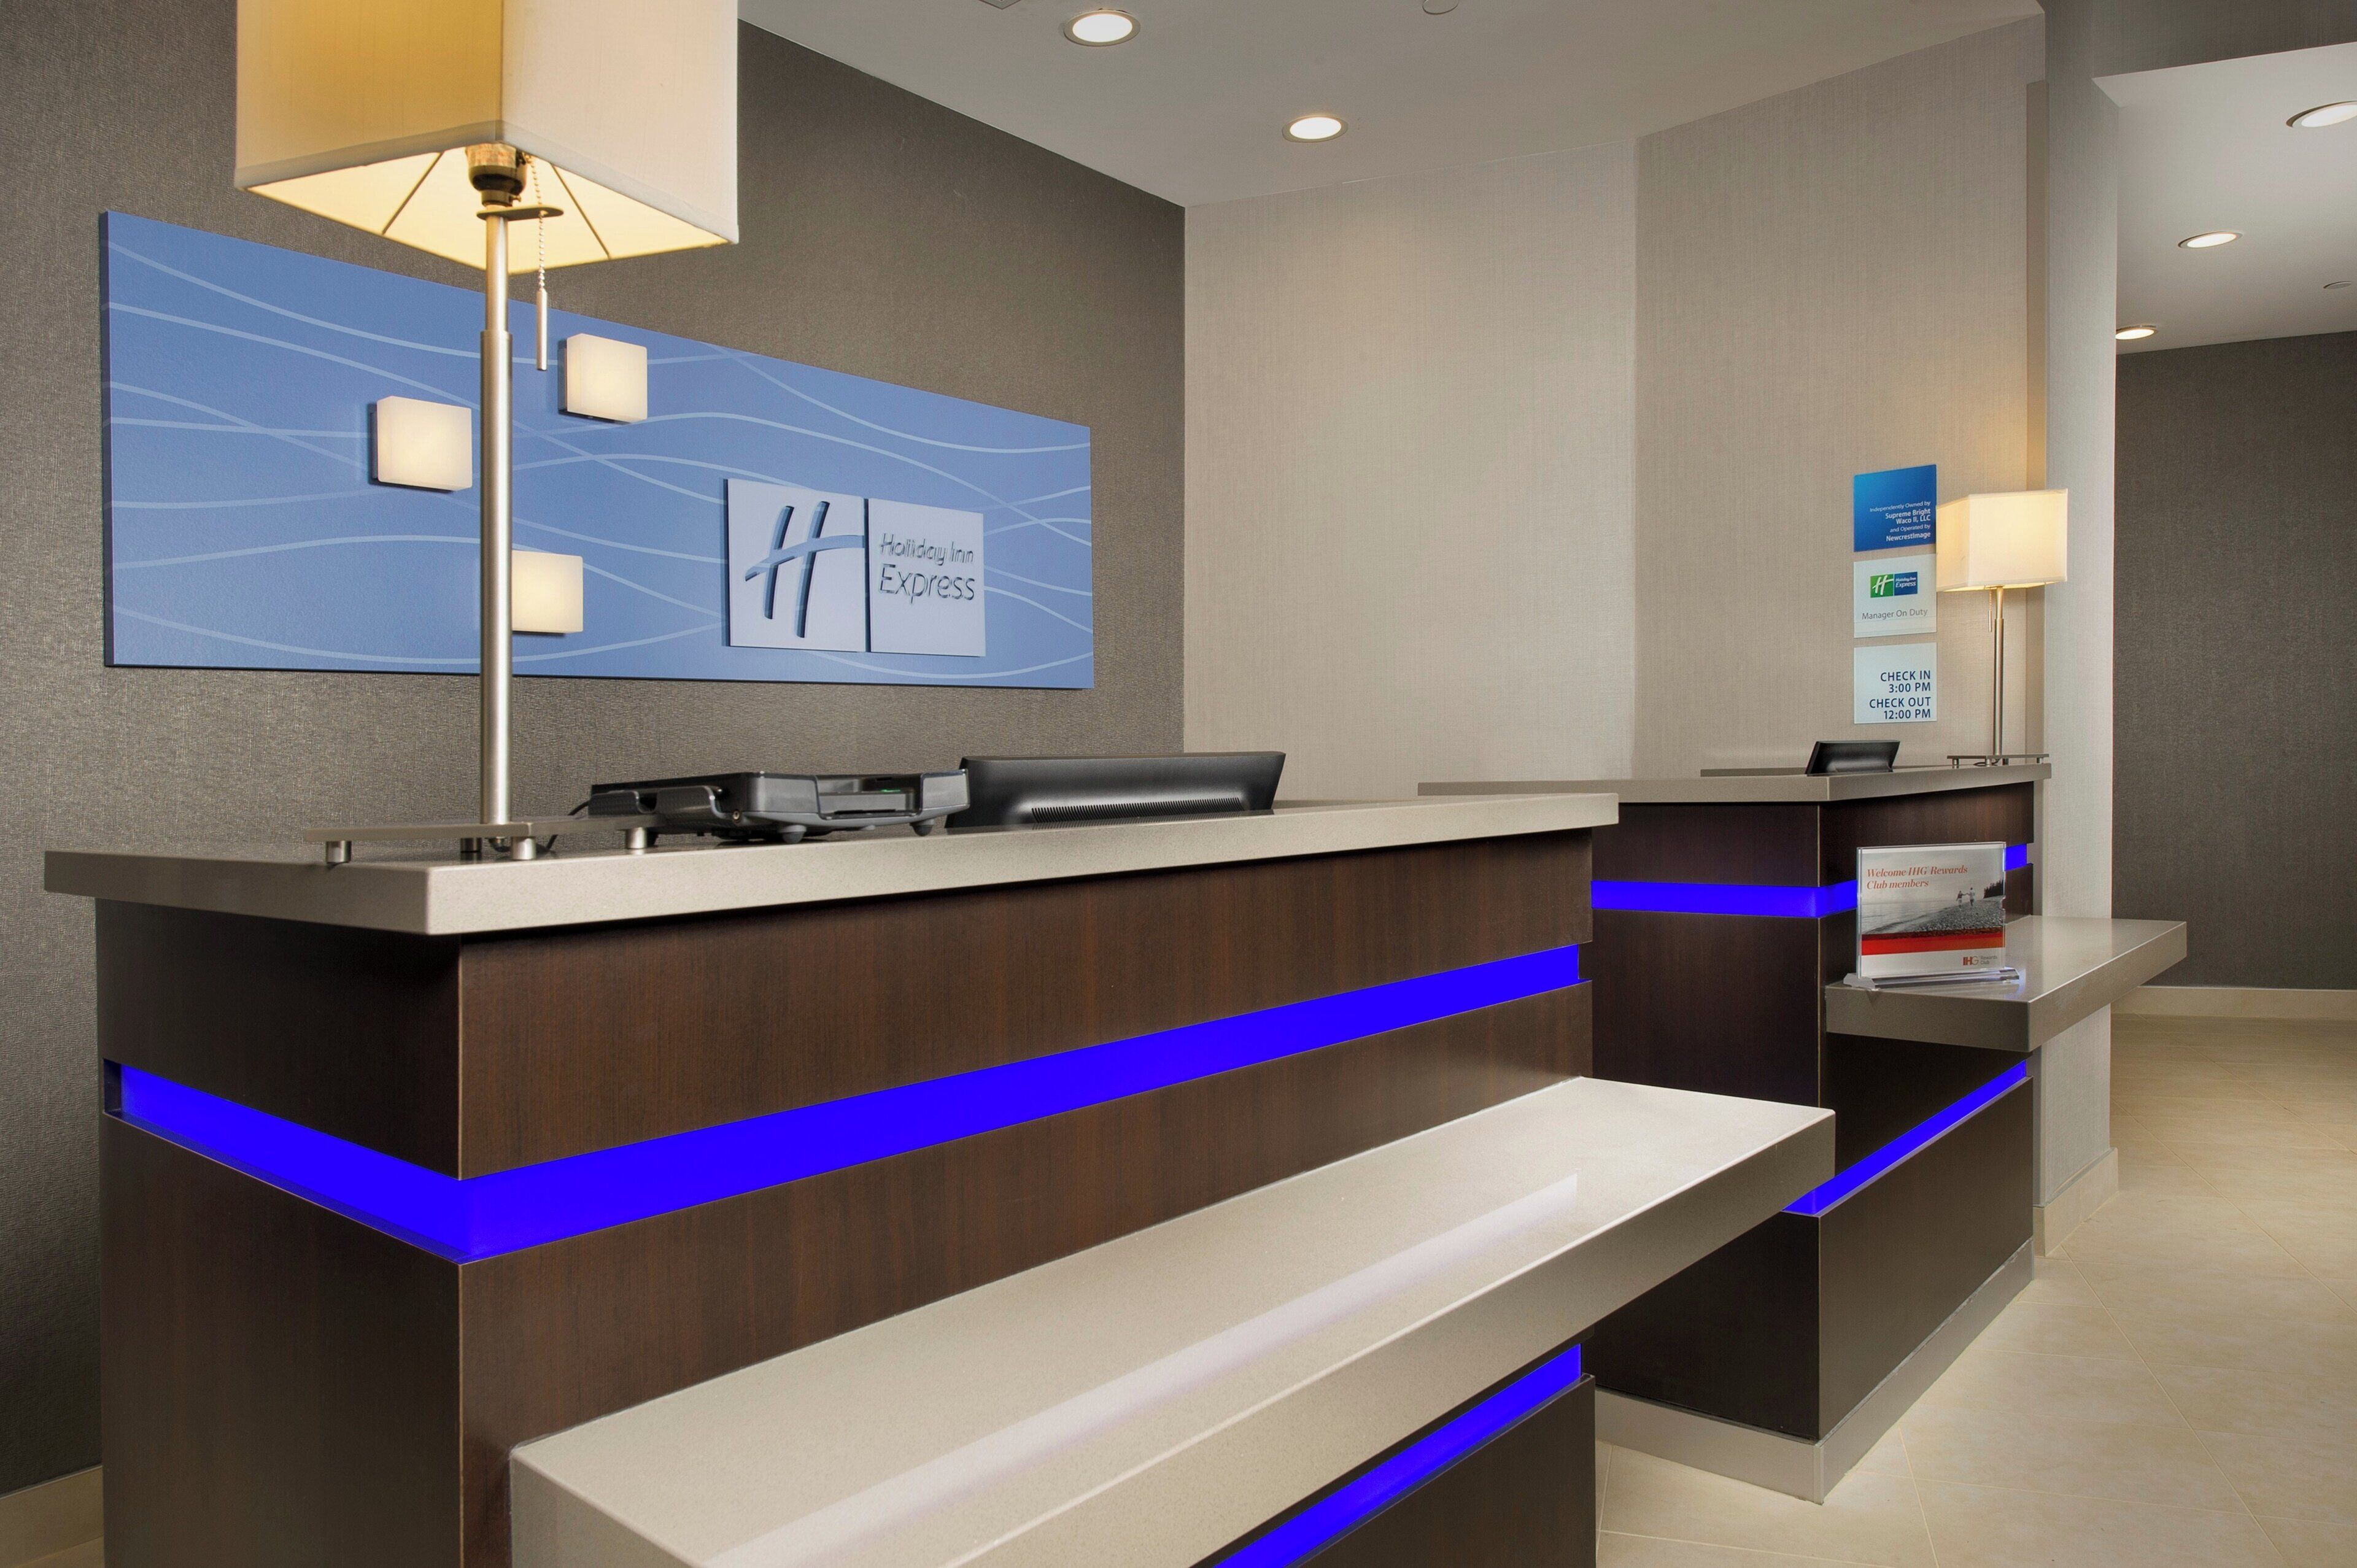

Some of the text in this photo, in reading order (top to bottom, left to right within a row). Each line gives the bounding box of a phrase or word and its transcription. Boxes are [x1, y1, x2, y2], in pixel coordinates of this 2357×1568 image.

[1886, 511, 1911, 519] Supreme
[1886, 532, 1930, 541] NewcrestImage
[880, 533, 973, 566] Holiday Inn
[880, 563, 975, 604] Express
[1881, 670, 1930, 681] CHECK IN
[1889, 682, 1930, 693] 3:00 PM
[1870, 697, 1931, 708] CHECK OUT
[1884, 709, 1930, 719] 12:00 PM
[1867, 865, 1968, 877] Welcome IHG Rewards
[1867, 879, 1929, 889] Club members
[1962, 956, 1979, 965] IHG
